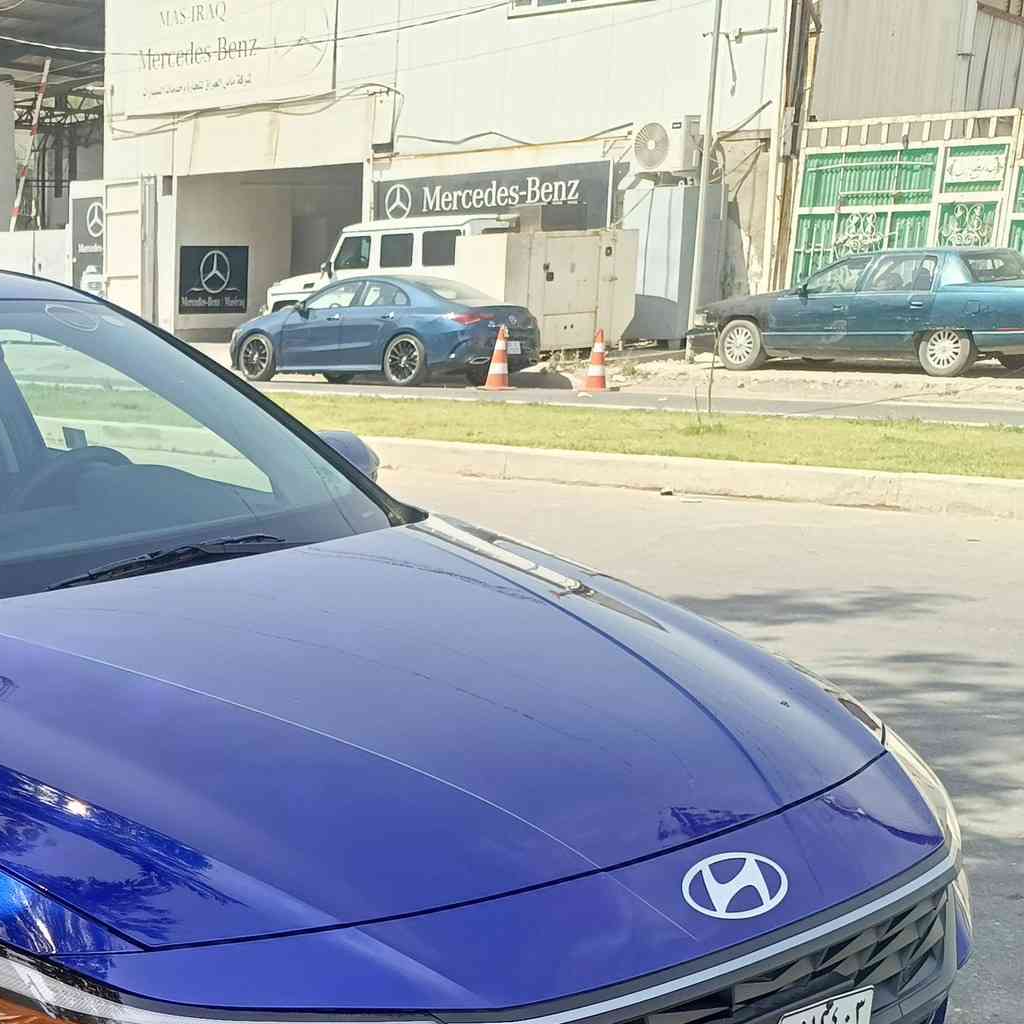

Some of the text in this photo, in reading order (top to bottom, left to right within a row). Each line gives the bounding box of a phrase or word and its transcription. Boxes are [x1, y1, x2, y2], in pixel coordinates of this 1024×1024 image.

[140, 36, 257, 71] Mercedes Benz
[422, 176, 580, 213] Mercedes-Benz
